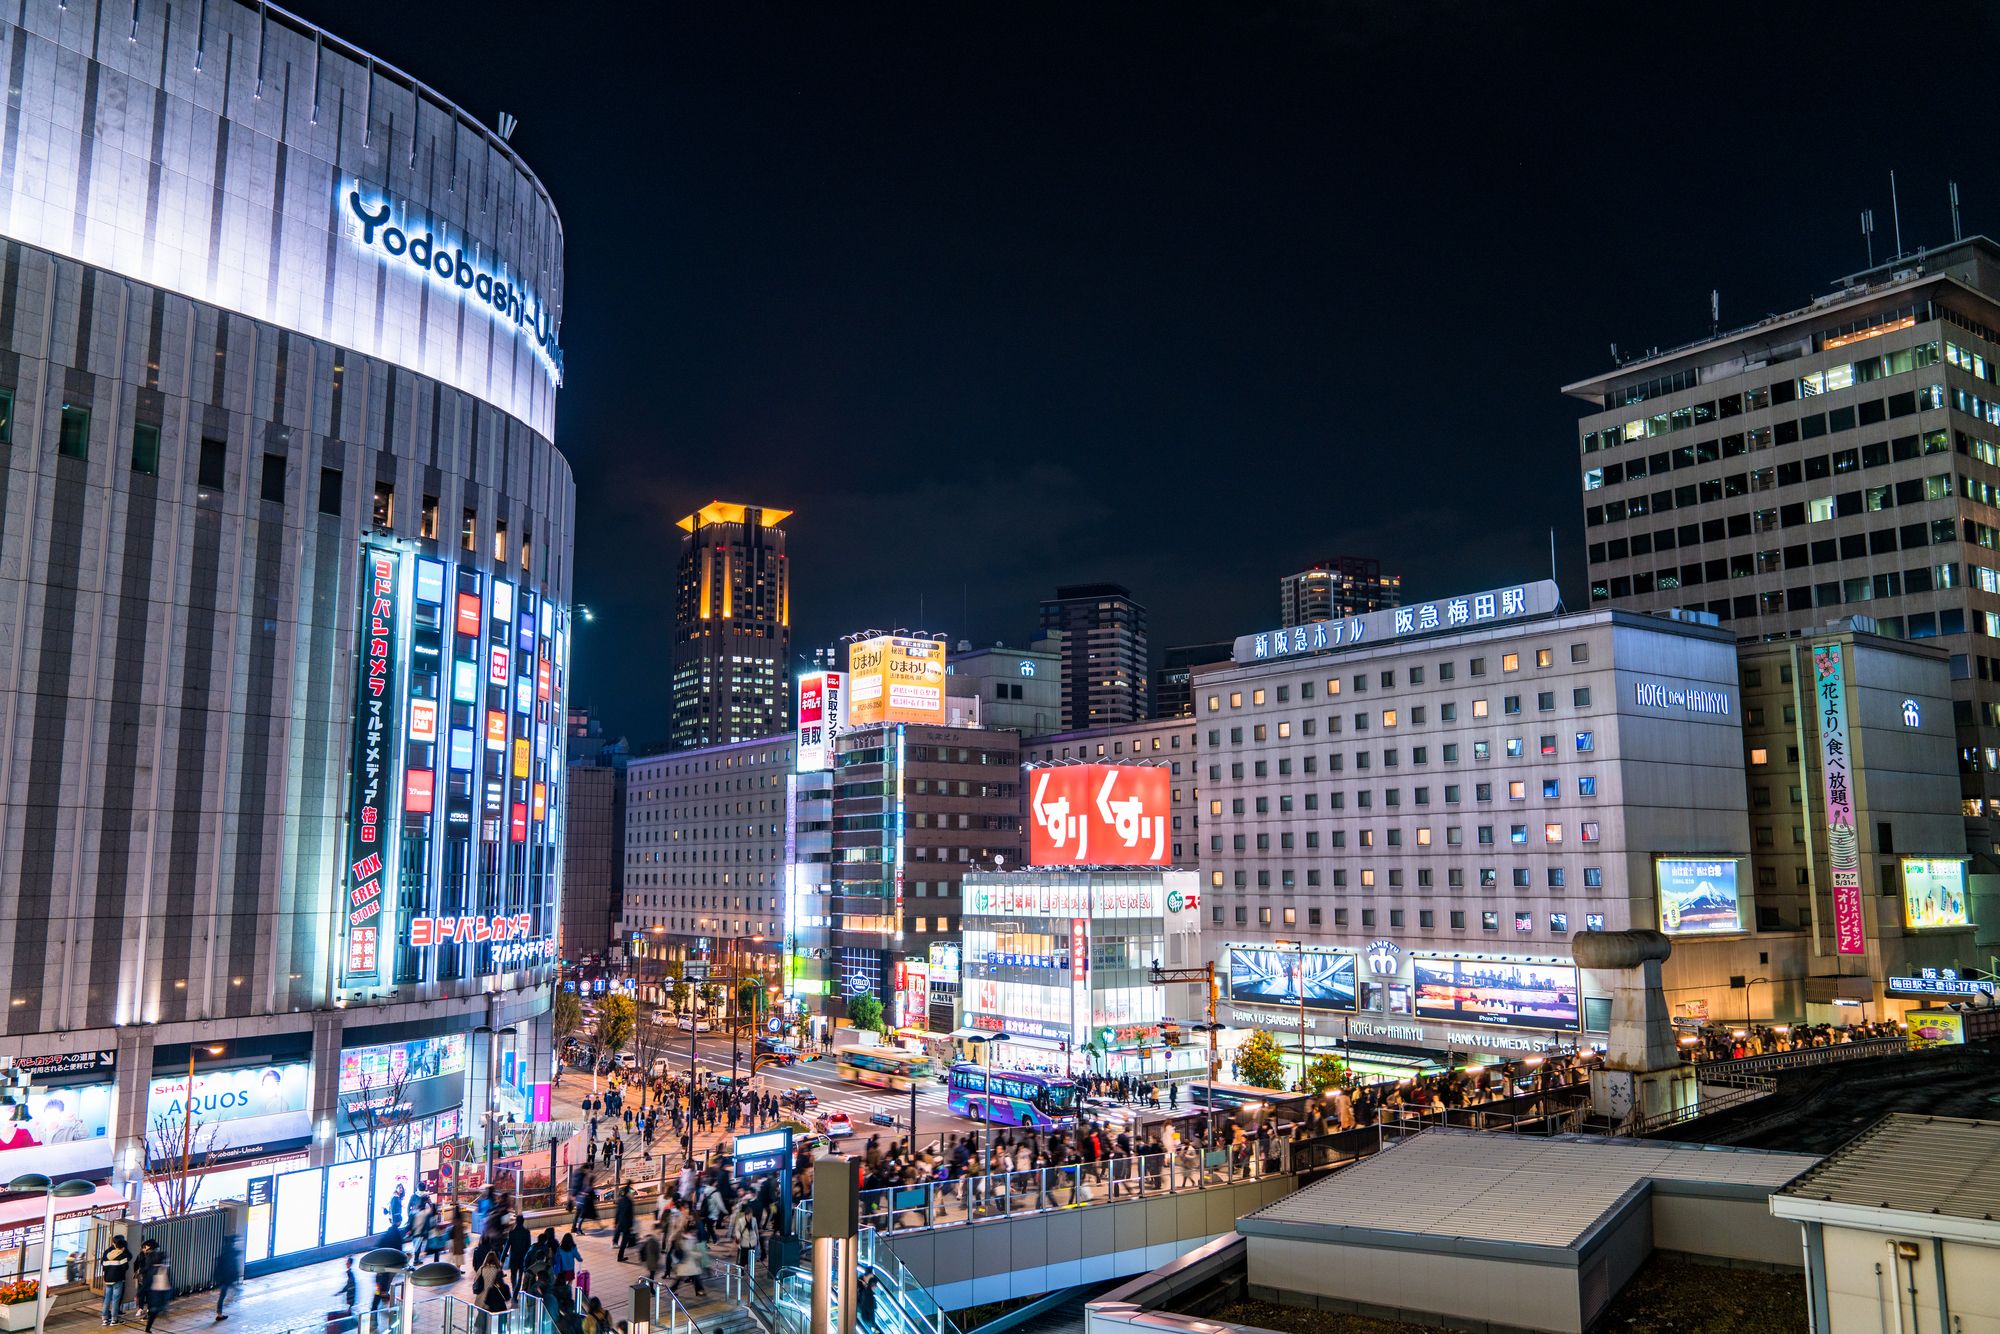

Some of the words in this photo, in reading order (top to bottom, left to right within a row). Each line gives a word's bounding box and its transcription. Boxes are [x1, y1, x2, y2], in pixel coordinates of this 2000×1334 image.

[369, 559, 393, 697] ヨドバシカメラ
[1255, 618, 1365, 658] 新阪急ホテル
[494, 655, 506, 667] UNI
[853, 651, 882, 670] ひまわり
[889, 660, 926, 675] ひまわり
[493, 666, 506, 678] QLO
[801, 697, 821, 711] キタムラ
[1636, 682, 1669, 708] HOTEL
[1669, 691, 1685, 705] new
[1686, 689, 1729, 715] HANKYU
[414, 709, 433, 721] BAN
[828, 690, 838, 748] 買取センター
[413, 720, 429, 731] DAI
[801, 726, 822, 747] 買取
[1821, 682, 1849, 813] 花より、食べ放題。
[1033, 773, 1088, 860] くすり
[1096, 770, 1165, 860] くすり
[352, 852, 382, 881] TAX
[351, 878, 381, 907] FREE
[989, 892, 1037, 909] スギ薬局
[1184, 895, 1200, 910] ス
[350, 900, 380, 926] STORE
[1849, 890, 1861, 949] グルメバイキング
[411, 913, 532, 947] ヨドバシカメラ
[1366, 940, 1400, 954] HANKYU
[1922, 967, 1957, 980] 阪急
[908, 974, 925, 994] 買取
[1232, 1010, 1264, 1024] HANKYU
[1265, 1015, 1316, 1029] SANBAN-GAI
[1350, 1021, 1374, 1037] HOTEL
[1373, 1026, 1387, 1035] new
[1387, 1026, 1425, 1042] HANKYU
[1447, 1032, 1490, 1047] HANKYU
[1492, 1037, 1531, 1051] UMEDA
[168, 1090, 249, 1116] AQUOS
[55, 1208, 92, 1221] ヨドバシカメラ
